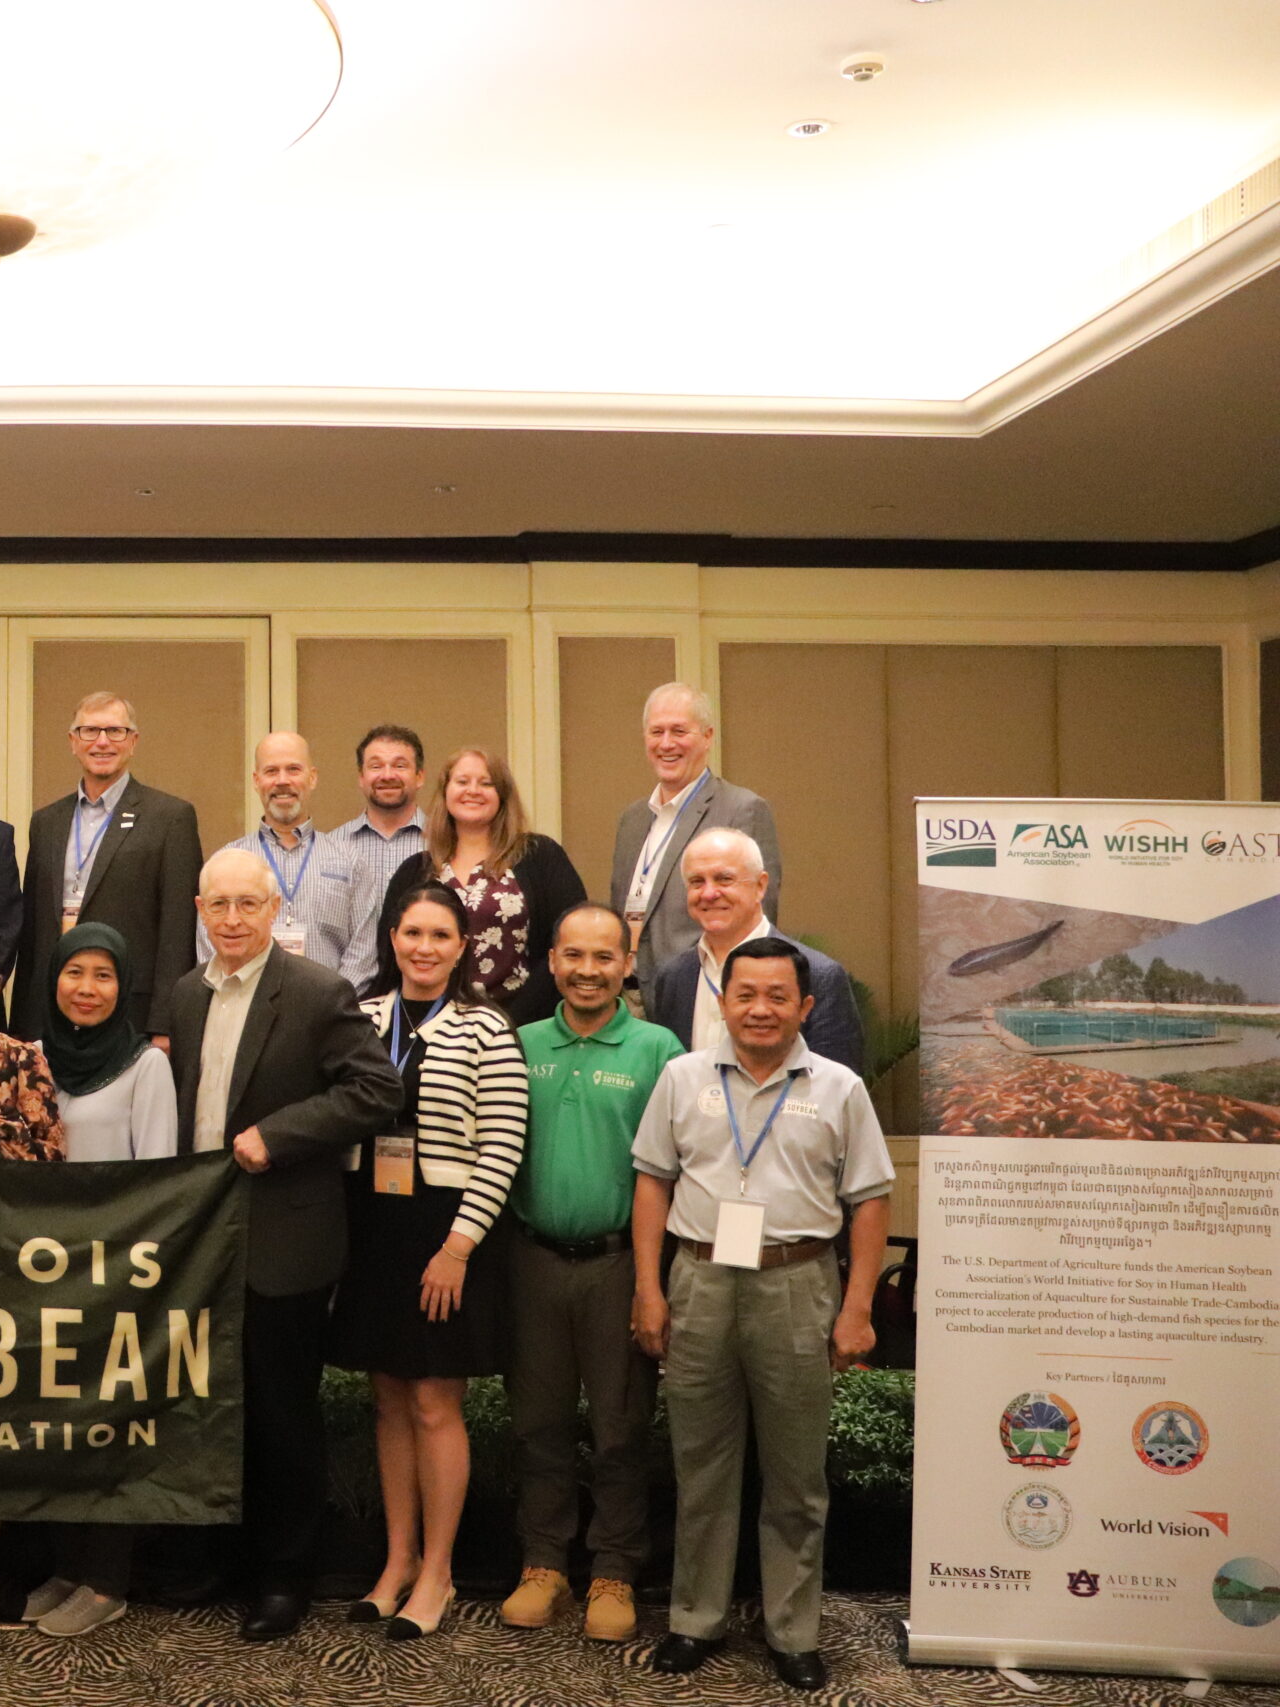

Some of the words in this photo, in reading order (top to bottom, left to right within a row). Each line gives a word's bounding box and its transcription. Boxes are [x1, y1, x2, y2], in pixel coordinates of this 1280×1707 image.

[925, 819, 996, 841] USDA
[1043, 825, 1089, 849] ASA
[1104, 835, 1189, 853] WISHH
[1007, 850, 1050, 858] American
[1052, 850, 1091, 861] Soybean
[1023, 858, 1076, 866] Association
[602, 1075, 635, 1088] SOYBEAN
[786, 1103, 818, 1115] SOYBEAN
[942, 1255, 961, 1265] The
[964, 1256, 985, 1266] U.S.
[988, 1257, 1047, 1269] Department
[1049, 1258, 1061, 1268] of
[1063, 1259, 1122, 1271] Agriculture
[1124, 1261, 1153, 1272] funds
[1156, 1263, 1173, 1272] the
[1175, 1264, 1225, 1274] American
[1227, 1265, 1273, 1278] Soybean
[966, 1274, 1032, 1284] Association's
[1034, 1275, 1064, 1285] World
[1067, 1276, 1115, 1287] Initiative
[1117, 1277, 1133, 1287] for
[1135, 1279, 1154, 1290] Soy
[1157, 1279, 1167, 1289] in
[1170, 1280, 1209, 1291] Human
[1212, 1281, 1247, 1292] Health
[935, 1288, 1030, 1301] Commercialization
[1032, 1291, 1043, 1301] of
[1045, 1292, 1108, 1304] Aquaculture
[1110, 1295, 1126, 1304] for
[1128, 1296, 1188, 1307] Sustainable
[935, 1306, 970, 1317] project
[973, 1307, 983, 1316] to
[986, 1307, 1036, 1318] accelerate
[1038, 1309, 1094, 1321] production
[1096, 1310, 1108, 1321] of
[1110, 1311, 1180, 1324] high-demand
[1183, 1314, 1201, 1324] fish
[1204, 1316, 1241, 1327] species
[1244, 1316, 1260, 1327] for
[1262, 1317, 1279, 1327] the
[946, 1322, 1005, 1334] Cambodian
[1008, 1325, 1042, 1335] market
[1044, 1326, 1063, 1336] and
[1066, 1326, 1107, 1339] develop
[1118, 1328, 1153, 1341] lasting
[1156, 1331, 1218, 1343] aquaculture
[1220, 1332, 1268, 1345] industry.
[1045, 1371, 1062, 1382] Key
[1065, 1372, 1104, 1383] Partners
[1100, 1518, 1152, 1535] World
[1157, 1521, 1210, 1538] Vision
[929, 1562, 986, 1578] KANSAS
[990, 1565, 1031, 1580] STATE
[929, 1580, 1031, 1592] UNIVERSITY
[1106, 1574, 1178, 1588] AUBURN
